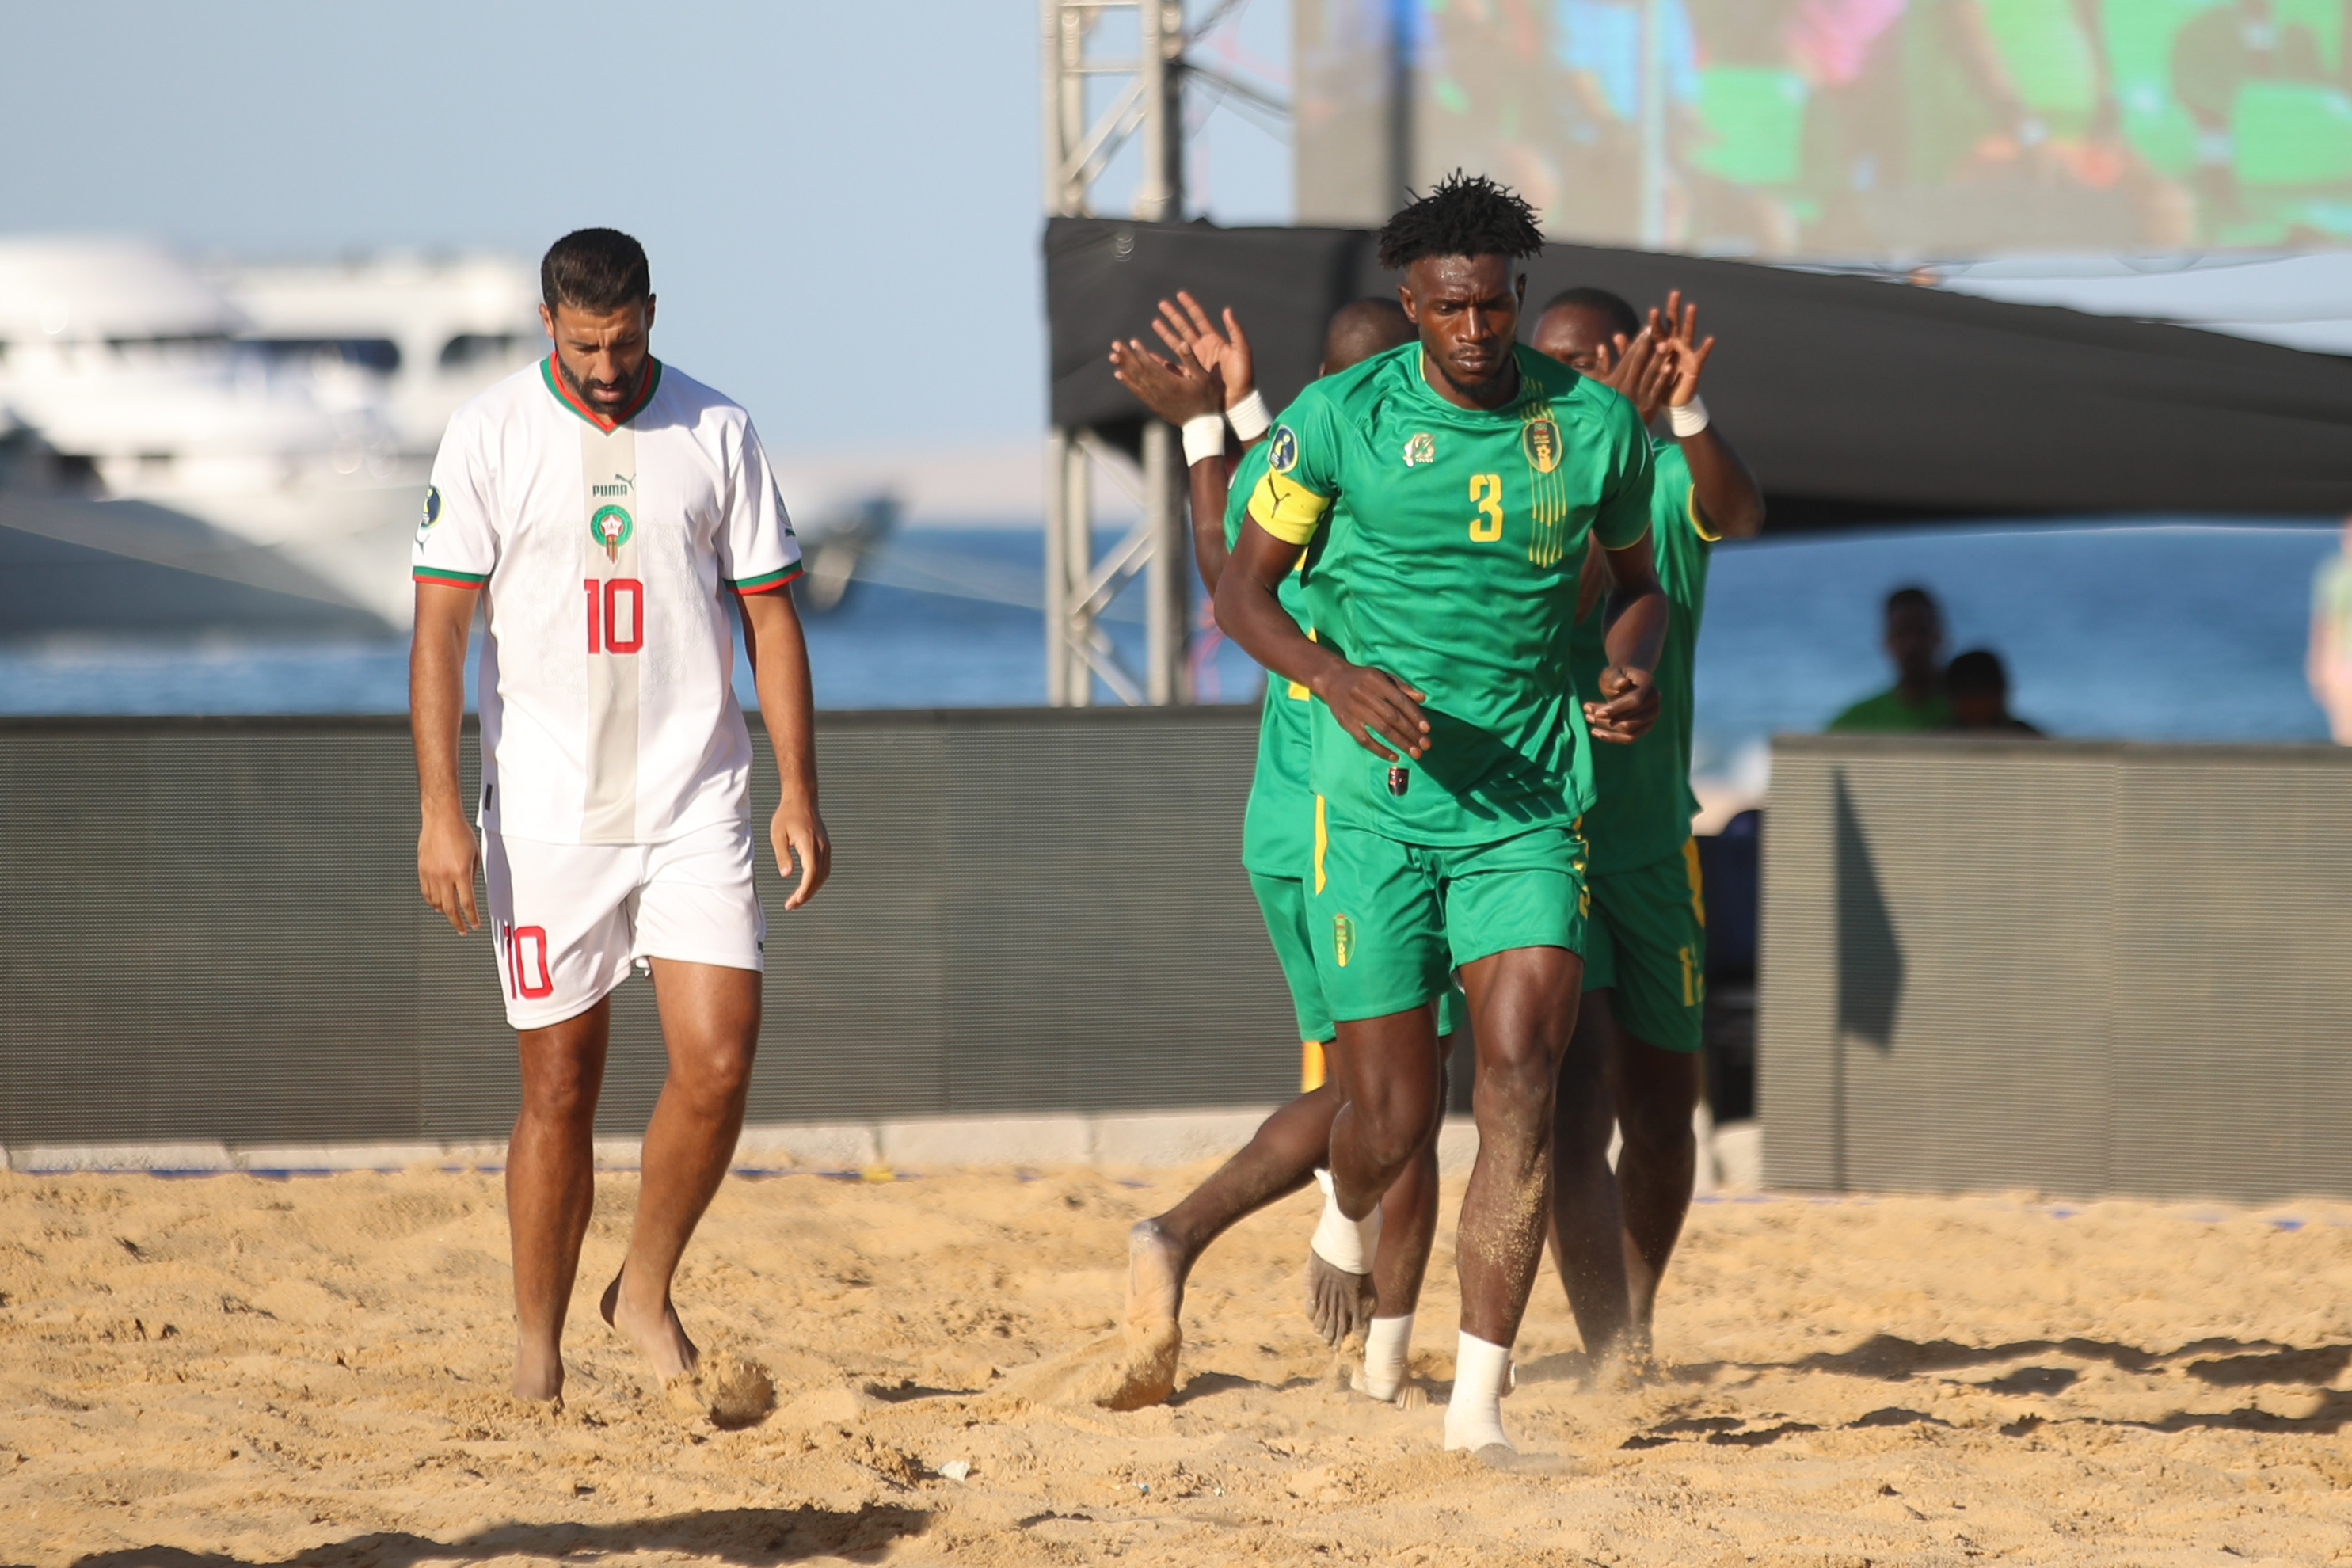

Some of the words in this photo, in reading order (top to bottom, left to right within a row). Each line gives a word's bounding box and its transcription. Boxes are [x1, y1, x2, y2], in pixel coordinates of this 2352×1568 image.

[592, 484, 627, 497] PUMA
[1469, 474, 1503, 542] 3
[584, 578, 643, 654] 10
[504, 925, 554, 1000] 10
